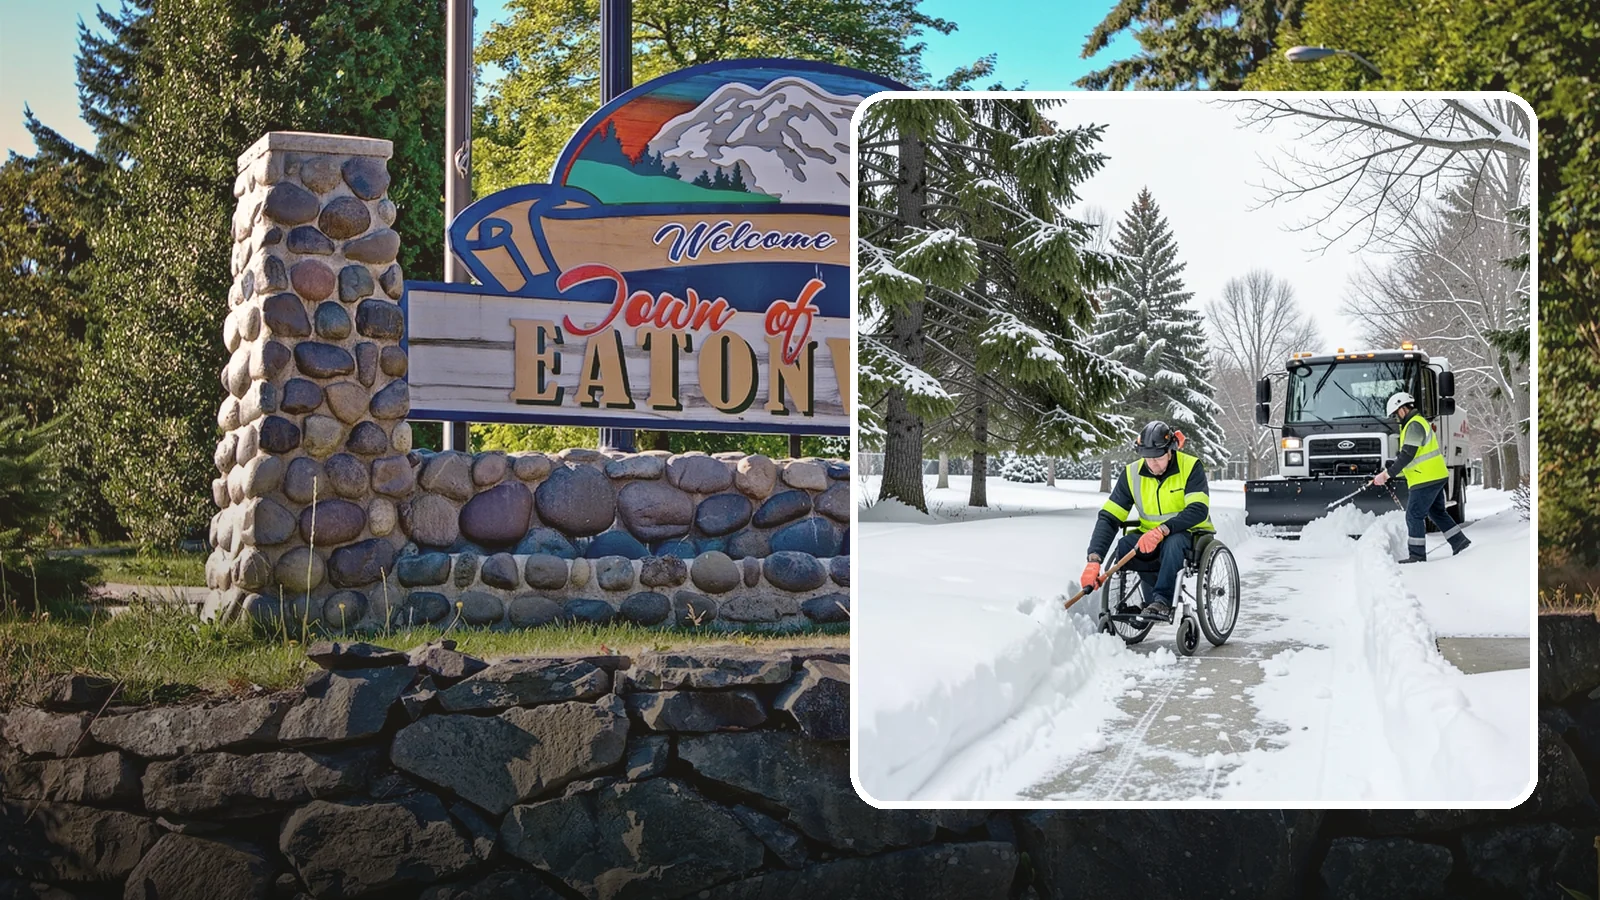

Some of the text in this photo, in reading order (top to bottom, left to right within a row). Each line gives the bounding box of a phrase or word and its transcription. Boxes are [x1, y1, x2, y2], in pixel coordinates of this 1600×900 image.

[654, 220, 836, 262] Welcome
[557, 263, 825, 365] Town of
